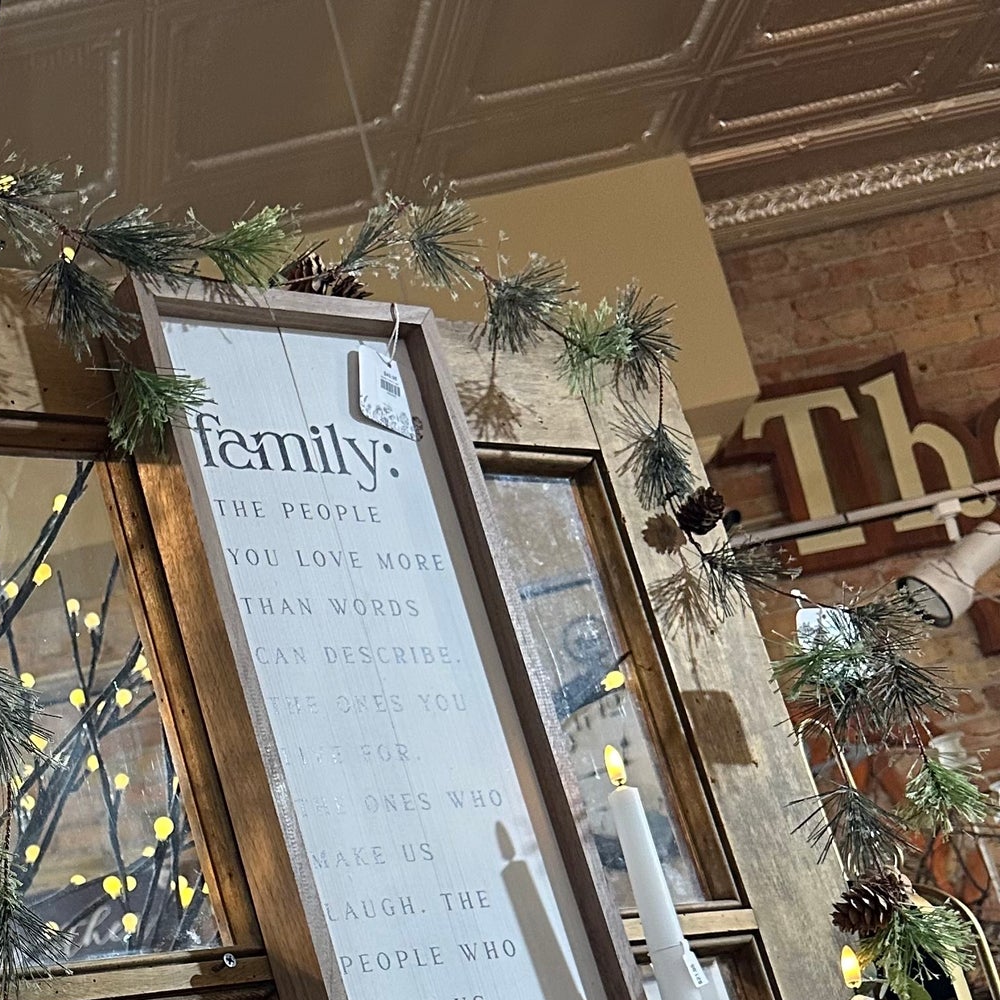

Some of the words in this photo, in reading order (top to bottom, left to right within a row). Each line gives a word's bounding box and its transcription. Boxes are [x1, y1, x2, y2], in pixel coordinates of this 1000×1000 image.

[196, 412, 400, 493] family:
[742, 371, 1000, 556] Th
[213, 498, 266, 519] THE
[282, 502, 382, 524] PEOPLE
[226, 547, 278, 567] YOU
[296, 549, 363, 570] LOVE
[378, 553, 446, 572] MORE
[239, 597, 314, 616] THAN
[328, 598, 420, 618] WORDS
[255, 646, 308, 665] CAN
[324, 646, 461, 665] DESCRIBE.
[336, 694, 404, 713] ONES
[417, 693, 467, 712] YOU
[364, 792, 432, 814] ONES
[446, 789, 503, 808] WHO
[312, 845, 387, 870] MAKE
[402, 842, 434, 863] US
[325, 896, 427, 922] LAUGH.
[440, 890, 491, 912] THE
[340, 946, 444, 975] PEOPLE
[459, 939, 517, 963] WHO
